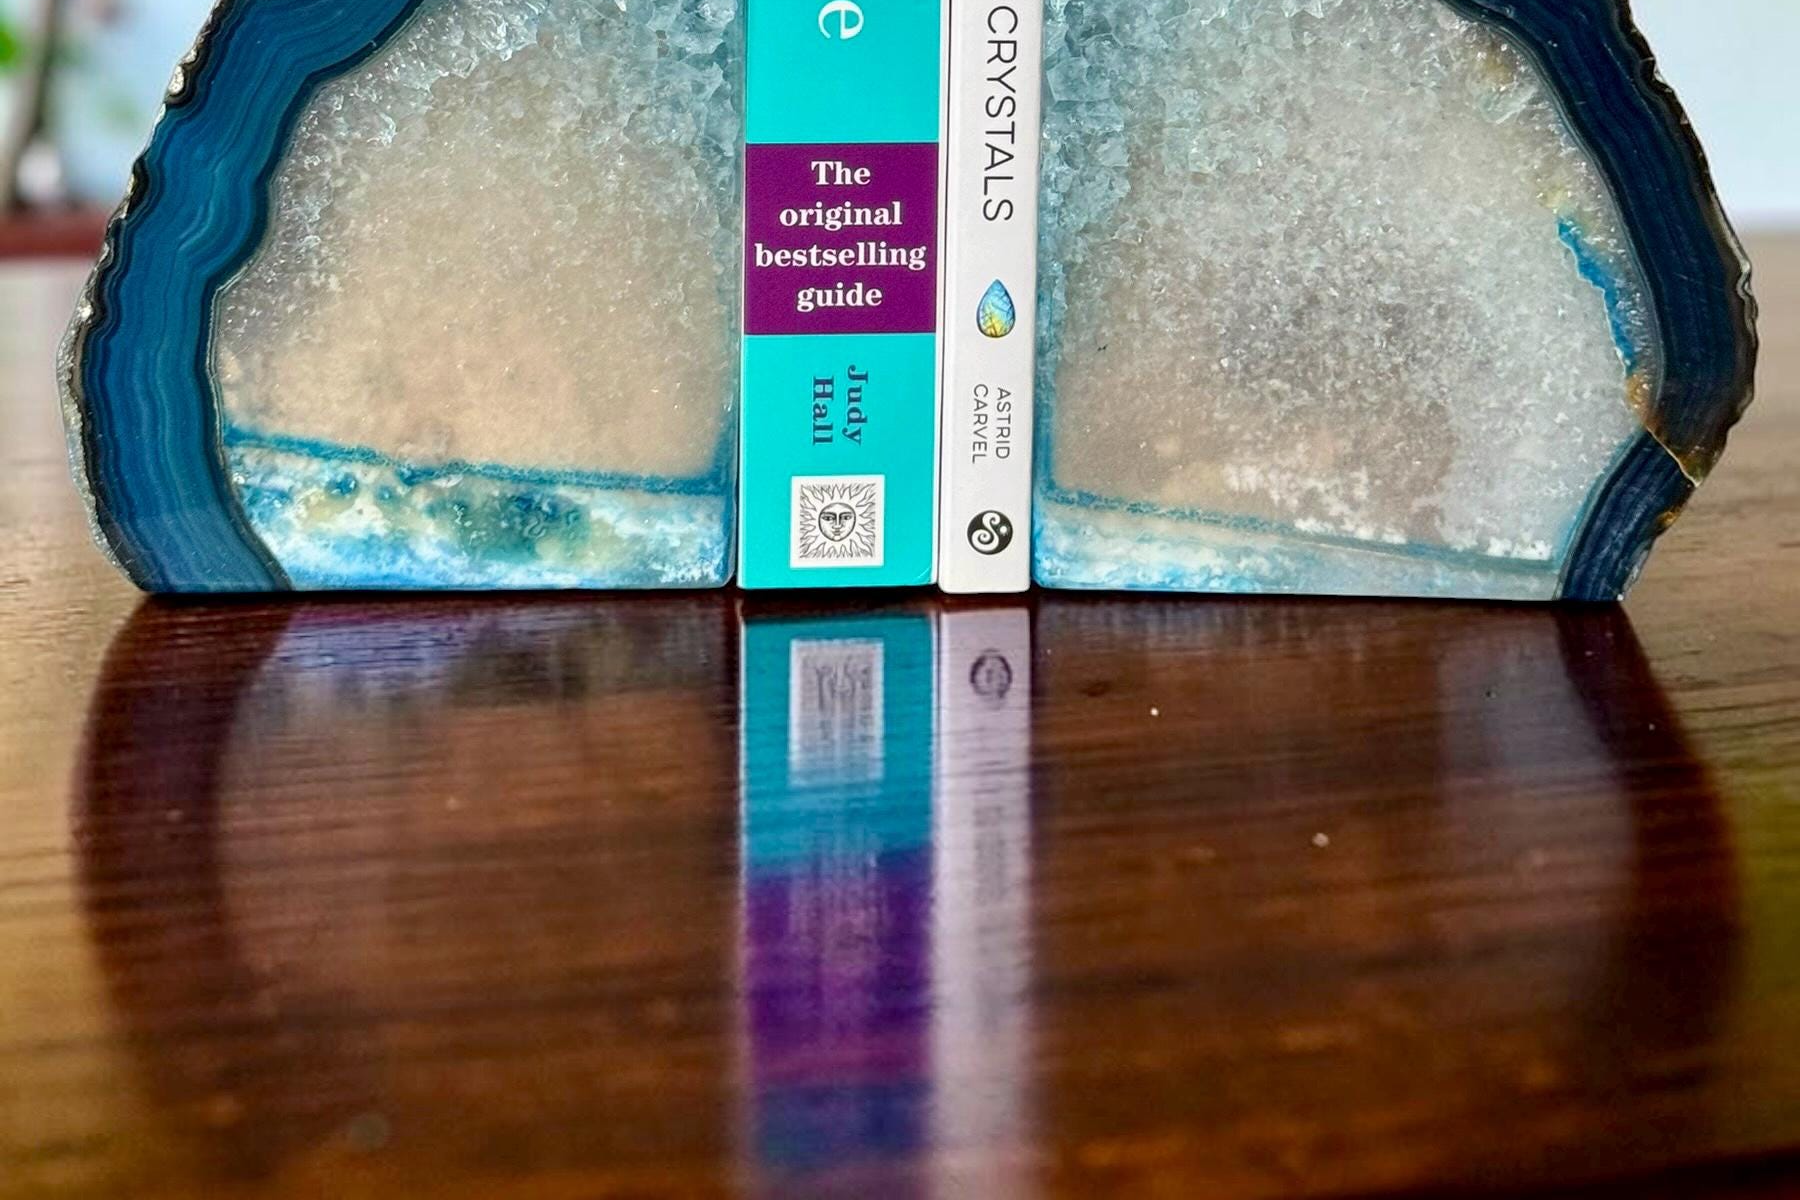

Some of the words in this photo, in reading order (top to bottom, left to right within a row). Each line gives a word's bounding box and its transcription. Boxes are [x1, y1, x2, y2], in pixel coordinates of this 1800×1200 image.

[983, 6, 1018, 221] CRYSTALS
[811, 160, 870, 185] The
[780, 201, 902, 231] original
[753, 240, 928, 270] bestselling
[797, 282, 882, 312] guide
[812, 377, 834, 444] Hall
[842, 365, 868, 444] Judy
[972, 384, 988, 463] CARVEL
[996, 388, 1011, 459] ASTRID
